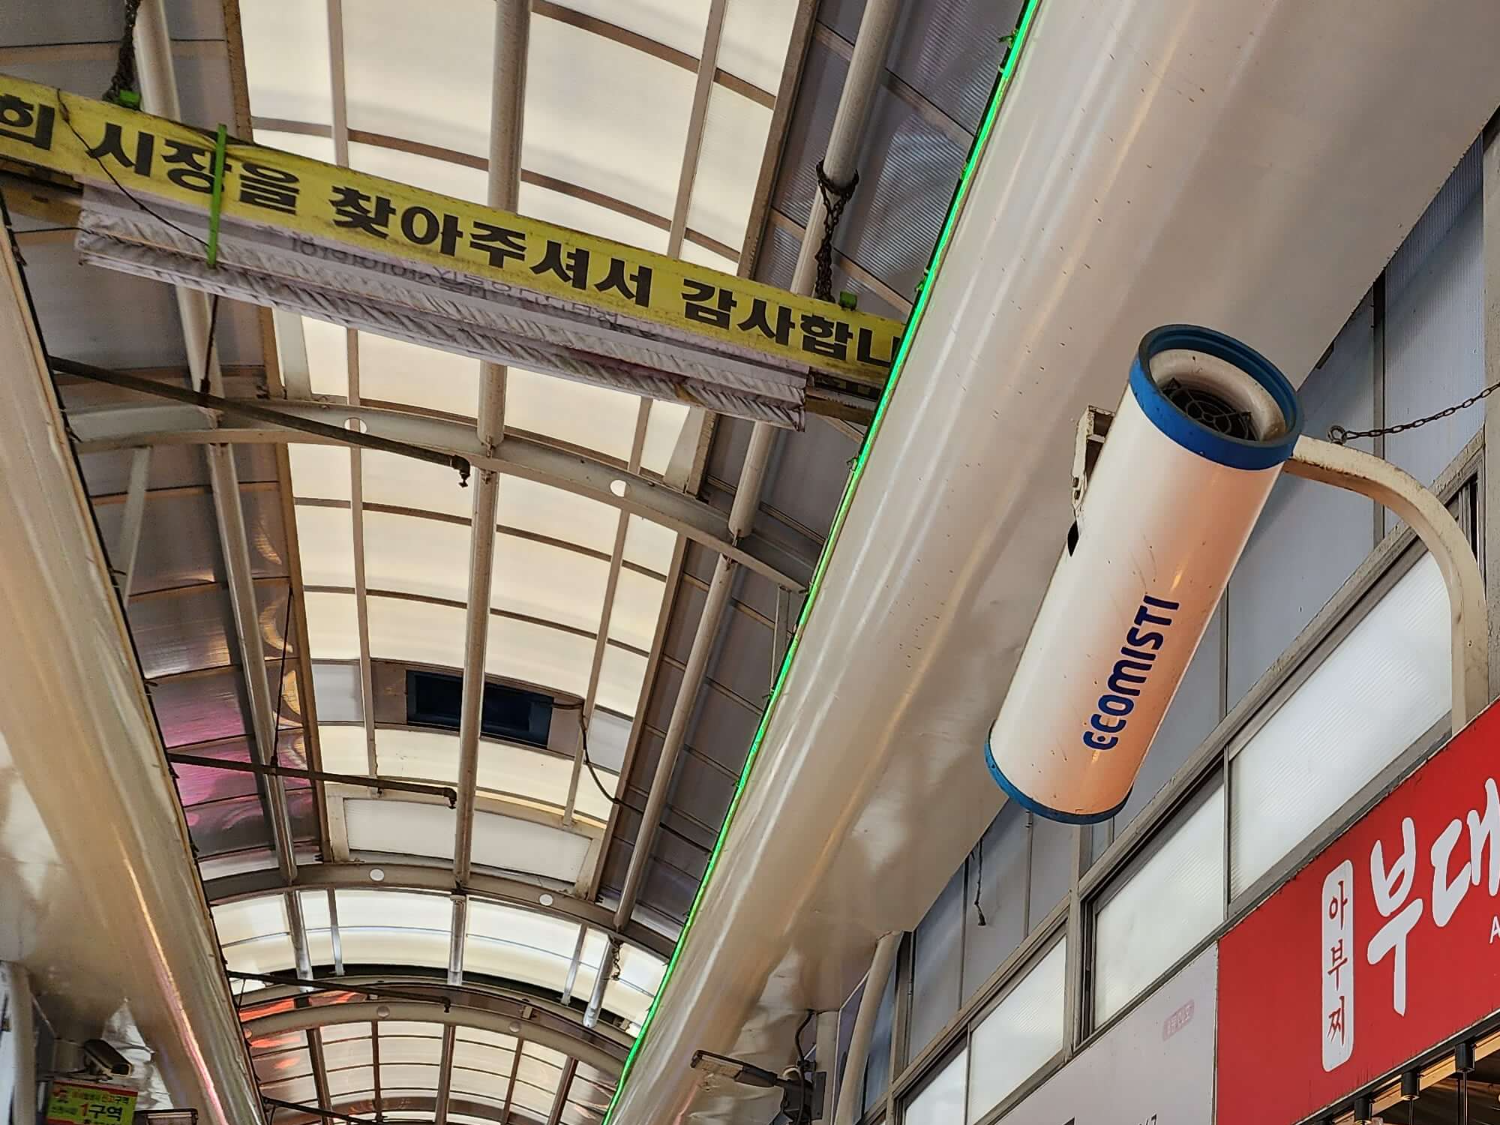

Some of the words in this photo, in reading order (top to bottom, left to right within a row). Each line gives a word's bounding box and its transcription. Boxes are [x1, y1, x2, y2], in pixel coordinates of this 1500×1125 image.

[86, 122, 299, 215] 시장을
[329, 185, 653, 308] 찾아주셔서
[1327, 880, 1349, 1047] 아부찌
